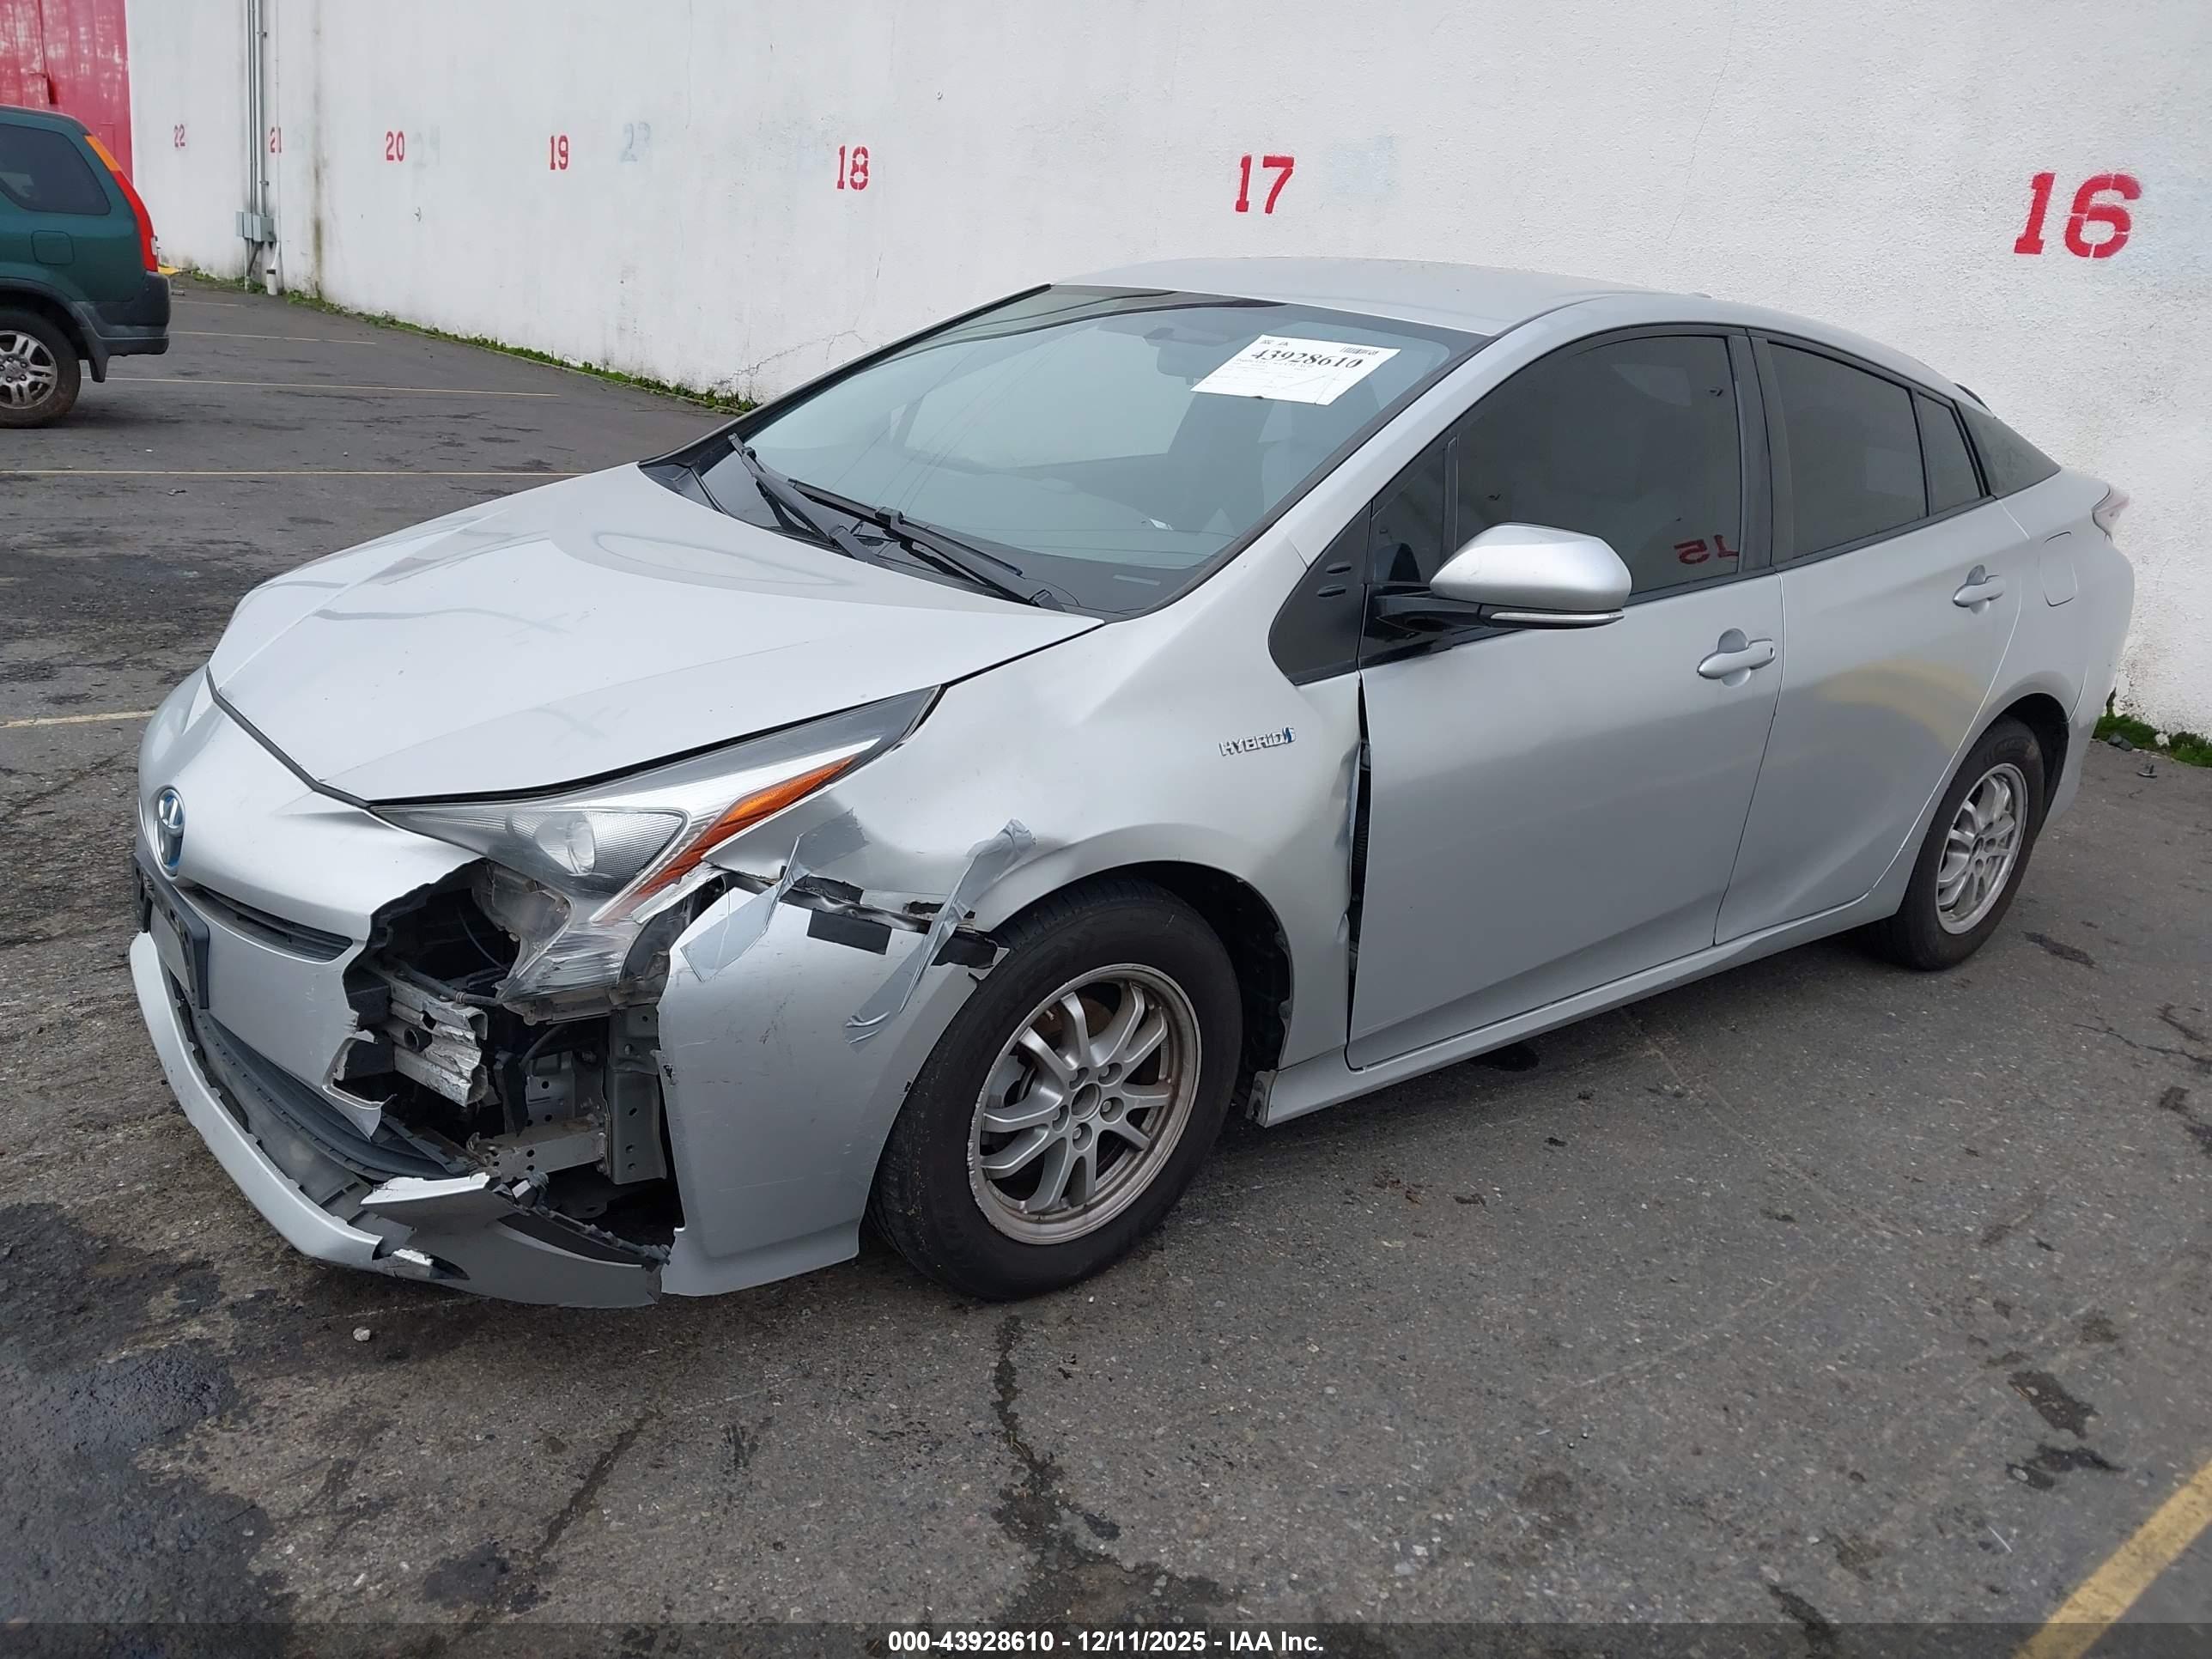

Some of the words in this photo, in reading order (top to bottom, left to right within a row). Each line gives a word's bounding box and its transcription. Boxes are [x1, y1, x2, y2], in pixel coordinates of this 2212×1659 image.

[173, 124, 185, 148] 22
[270, 127, 282, 153] 21
[386, 131, 404, 162] 20
[550, 135, 568, 170] 19
[836, 145, 869, 191] 18
[1235, 155, 1294, 214] 17
[2014, 172, 2142, 258] 16
[1251, 349, 1364, 369] 43928610
[1218, 732, 1285, 757] HYBRID
